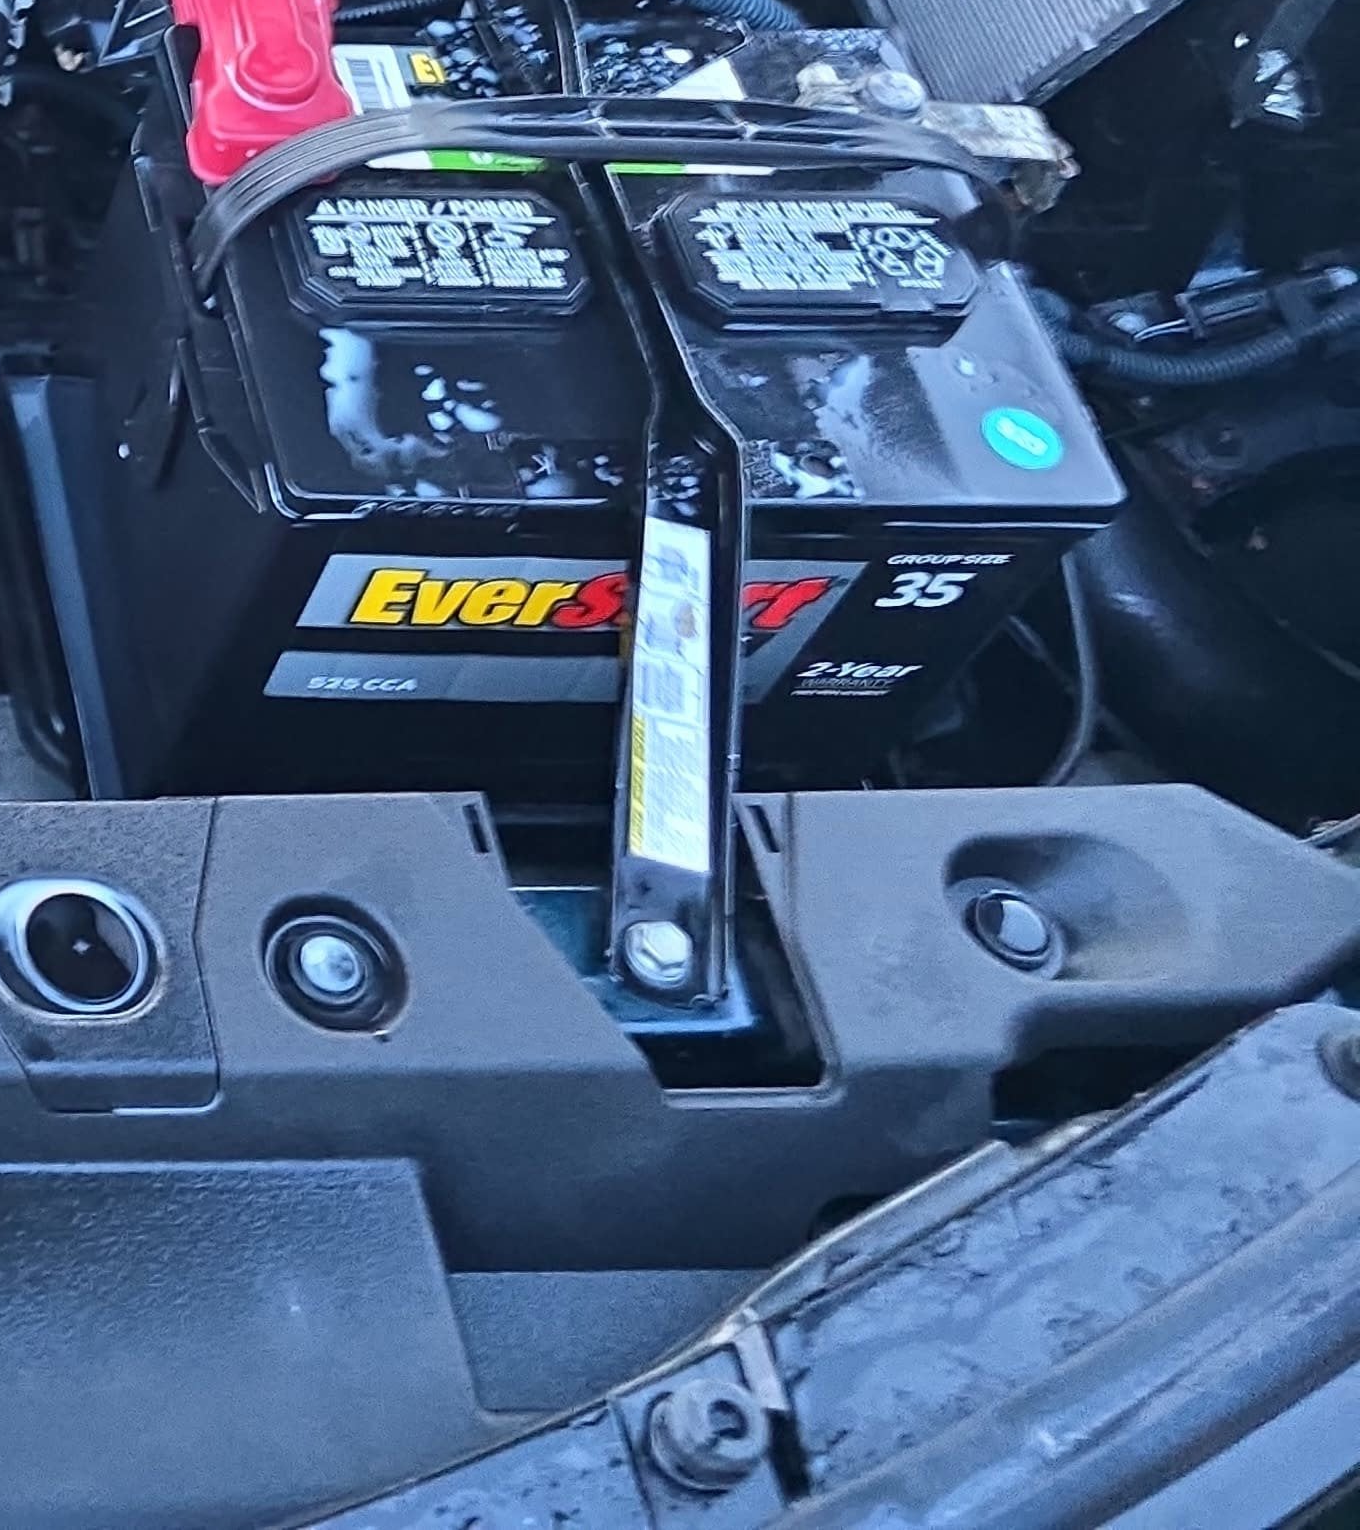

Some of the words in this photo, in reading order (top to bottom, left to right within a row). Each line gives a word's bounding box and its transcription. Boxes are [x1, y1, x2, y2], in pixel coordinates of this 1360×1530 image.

[887, 554, 966, 565] GROUP
[960, 554, 1016, 565] SIZE
[874, 571, 978, 608] 35
[796, 661, 923, 678] 2-Year
